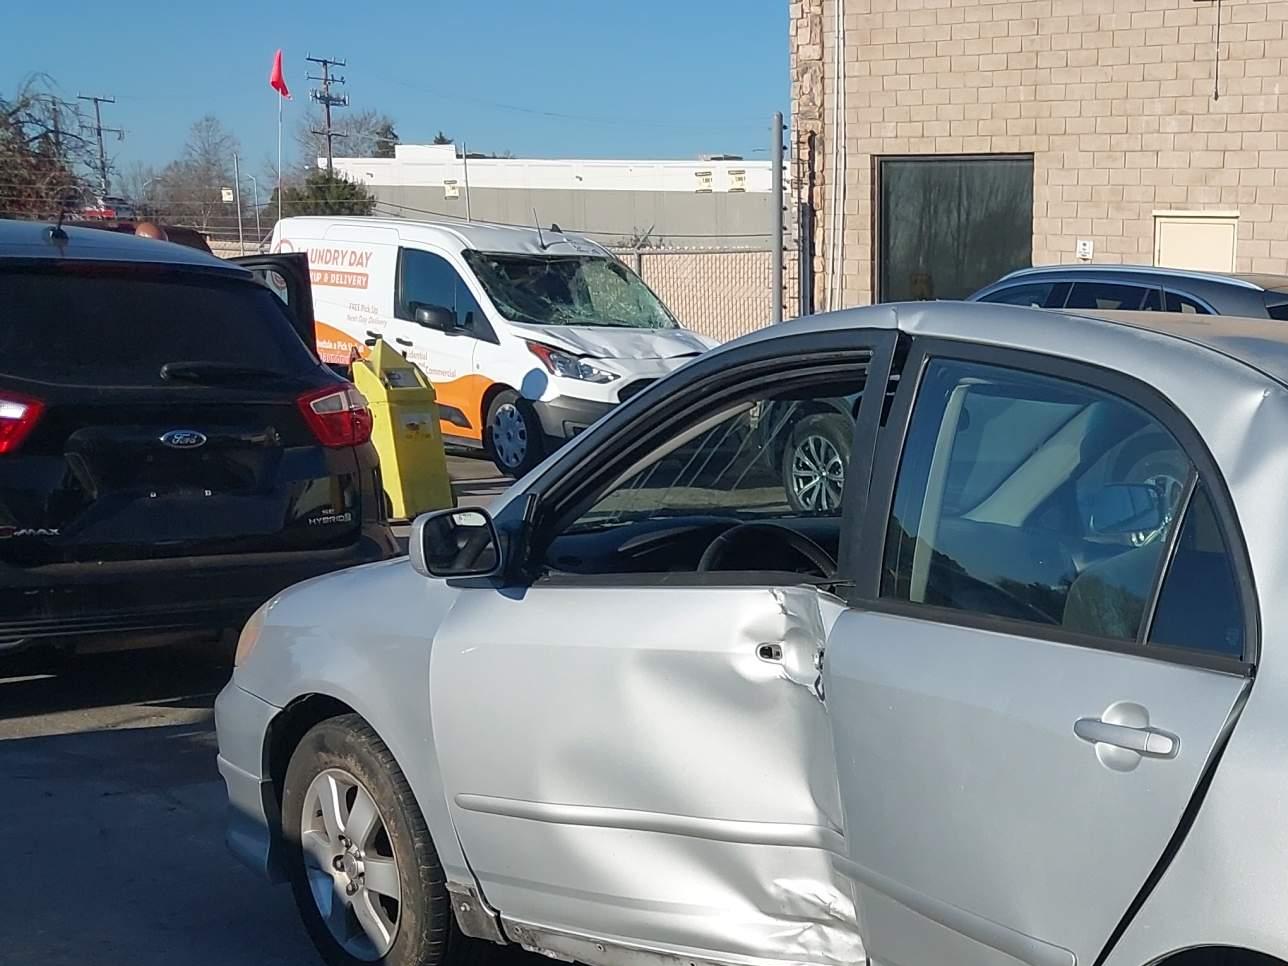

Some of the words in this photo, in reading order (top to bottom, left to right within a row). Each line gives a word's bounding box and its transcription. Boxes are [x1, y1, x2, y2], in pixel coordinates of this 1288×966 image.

[305, 247, 347, 266] UNDRY
[349, 250, 373, 268] DAY
[330, 273, 367, 287] DELIVERY
[168, 432, 200, 446] Ford
[308, 515, 345, 525] HYBRID
